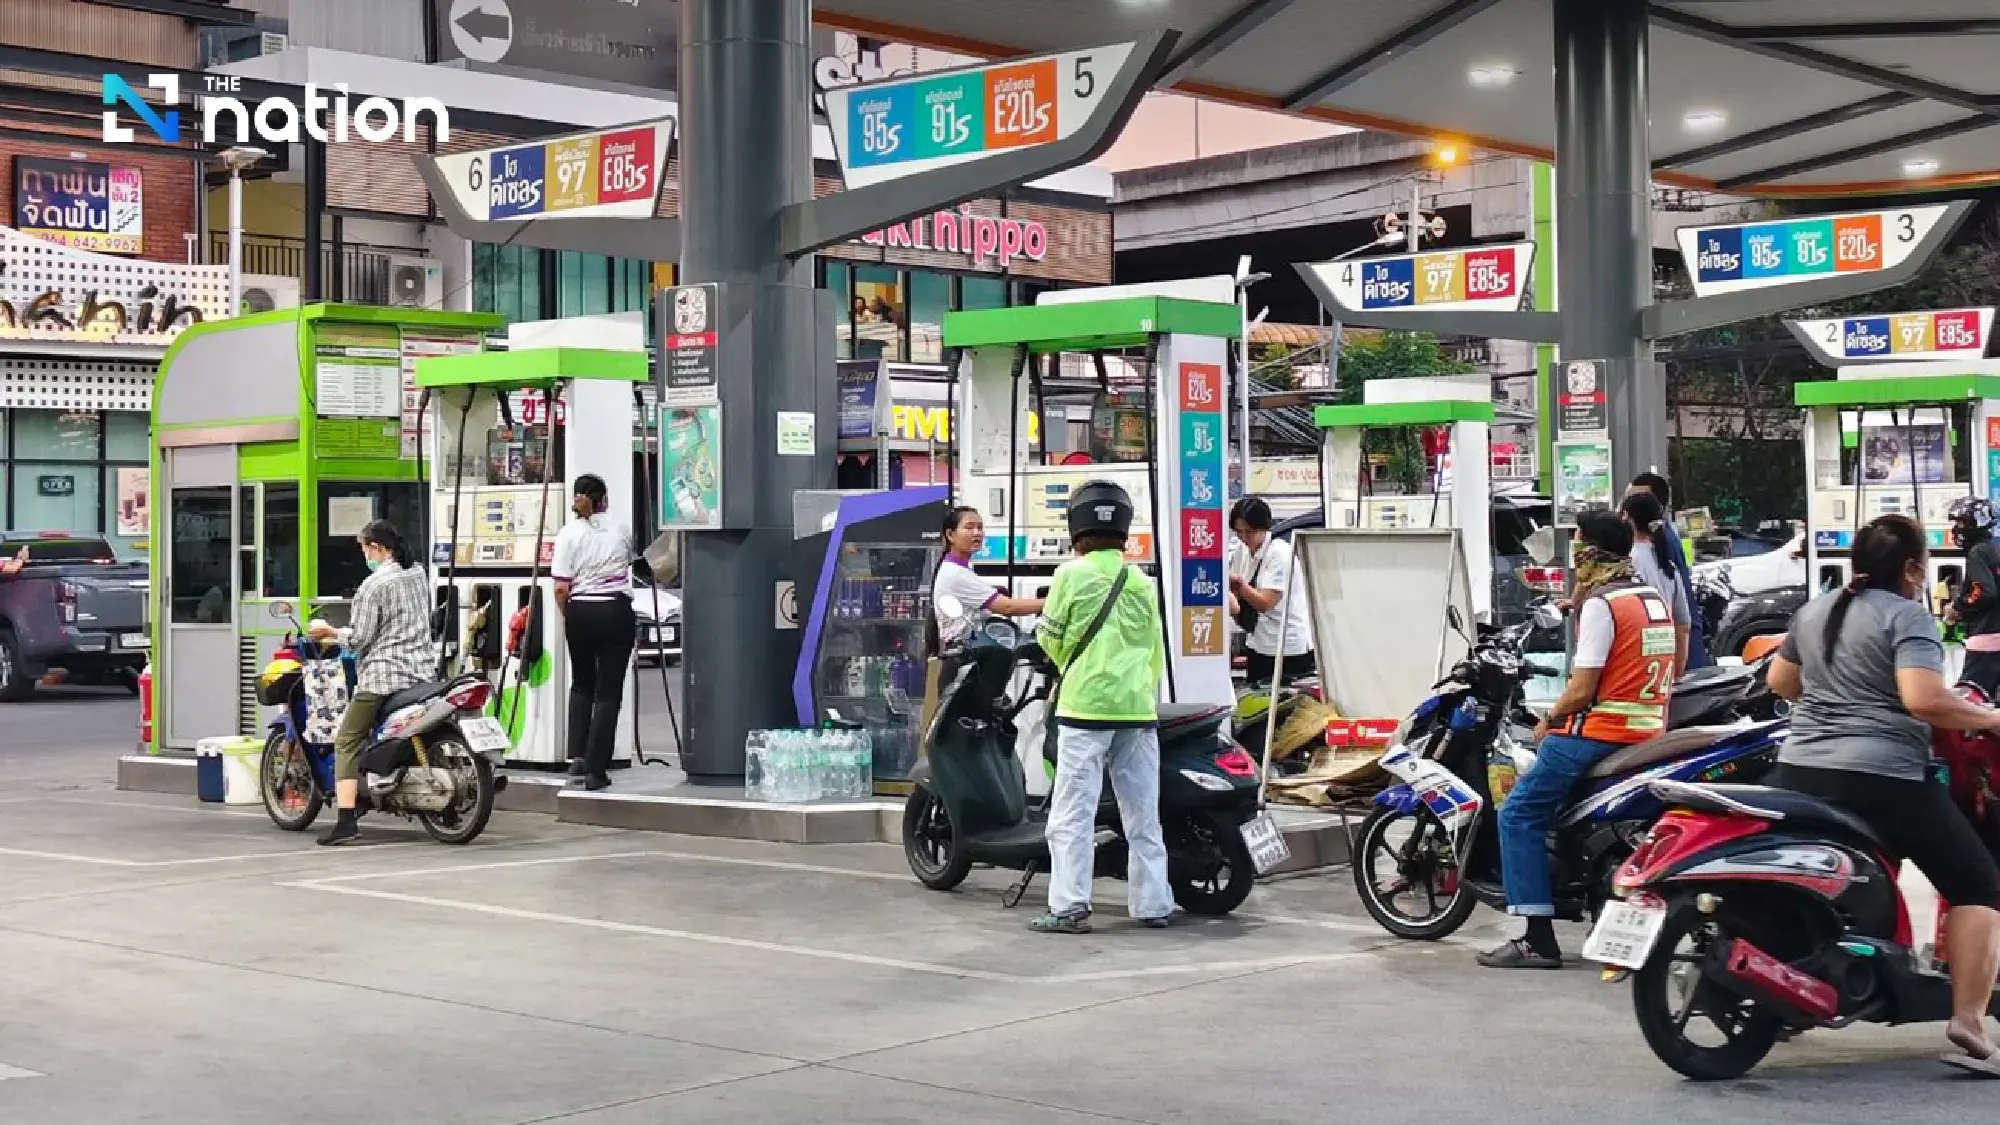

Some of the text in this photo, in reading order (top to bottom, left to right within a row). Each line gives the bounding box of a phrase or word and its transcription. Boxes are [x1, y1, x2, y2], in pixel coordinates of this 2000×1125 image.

[1074, 56, 1095, 98] 5
[468, 157, 483, 191] 6
[557, 160, 586, 193] 97
[22, 194, 107, 230] จัดฟัน
[1897, 214, 1915, 242] 3
[933, 202, 1047, 267] hippo
[1341, 265, 1355, 288] 4
[1427, 270, 1453, 293] 97
[1825, 322, 1838, 342] 2
[1901, 327, 1925, 346] 97
[1639, 659, 1674, 700] 24
